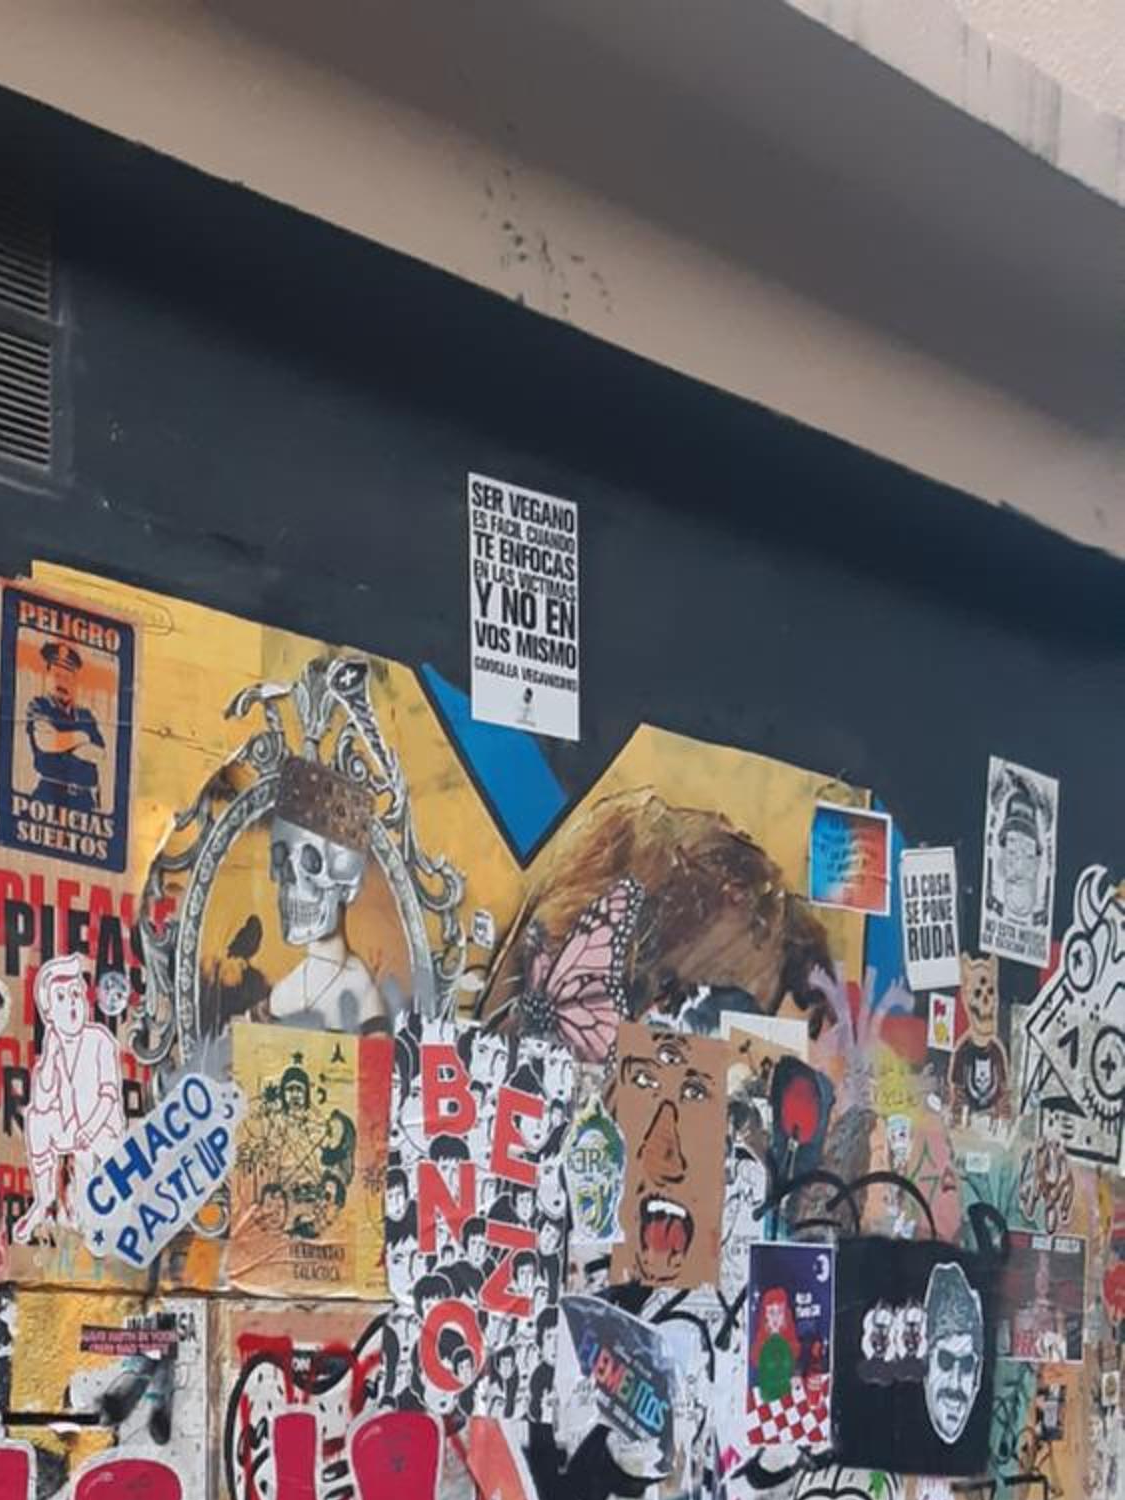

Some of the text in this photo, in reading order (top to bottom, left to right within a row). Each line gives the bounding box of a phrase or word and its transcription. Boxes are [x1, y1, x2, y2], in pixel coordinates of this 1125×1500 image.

[472, 481, 574, 533] SER VEGANO
[473, 530, 574, 581] TE ENFOCAS
[474, 510, 487, 530] ES
[526, 525, 575, 555] CUANDO
[475, 559, 489, 579] EN
[492, 563, 515, 586] LAS
[17, 601, 122, 653] PELIGRO
[475, 579, 575, 640] Y NO EN
[475, 620, 576, 669] VOS MISMO
[11, 794, 115, 839] POLICIAS
[16, 821, 109, 861] SUELTOS
[904, 873, 952, 898] LA COSA
[906, 898, 953, 924] SE PONE
[908, 923, 955, 962] RUDA
[87, 1077, 212, 1216] CHACO
[116, 1155, 204, 1265] PASTE
[194, 1126, 229, 1181] UP
